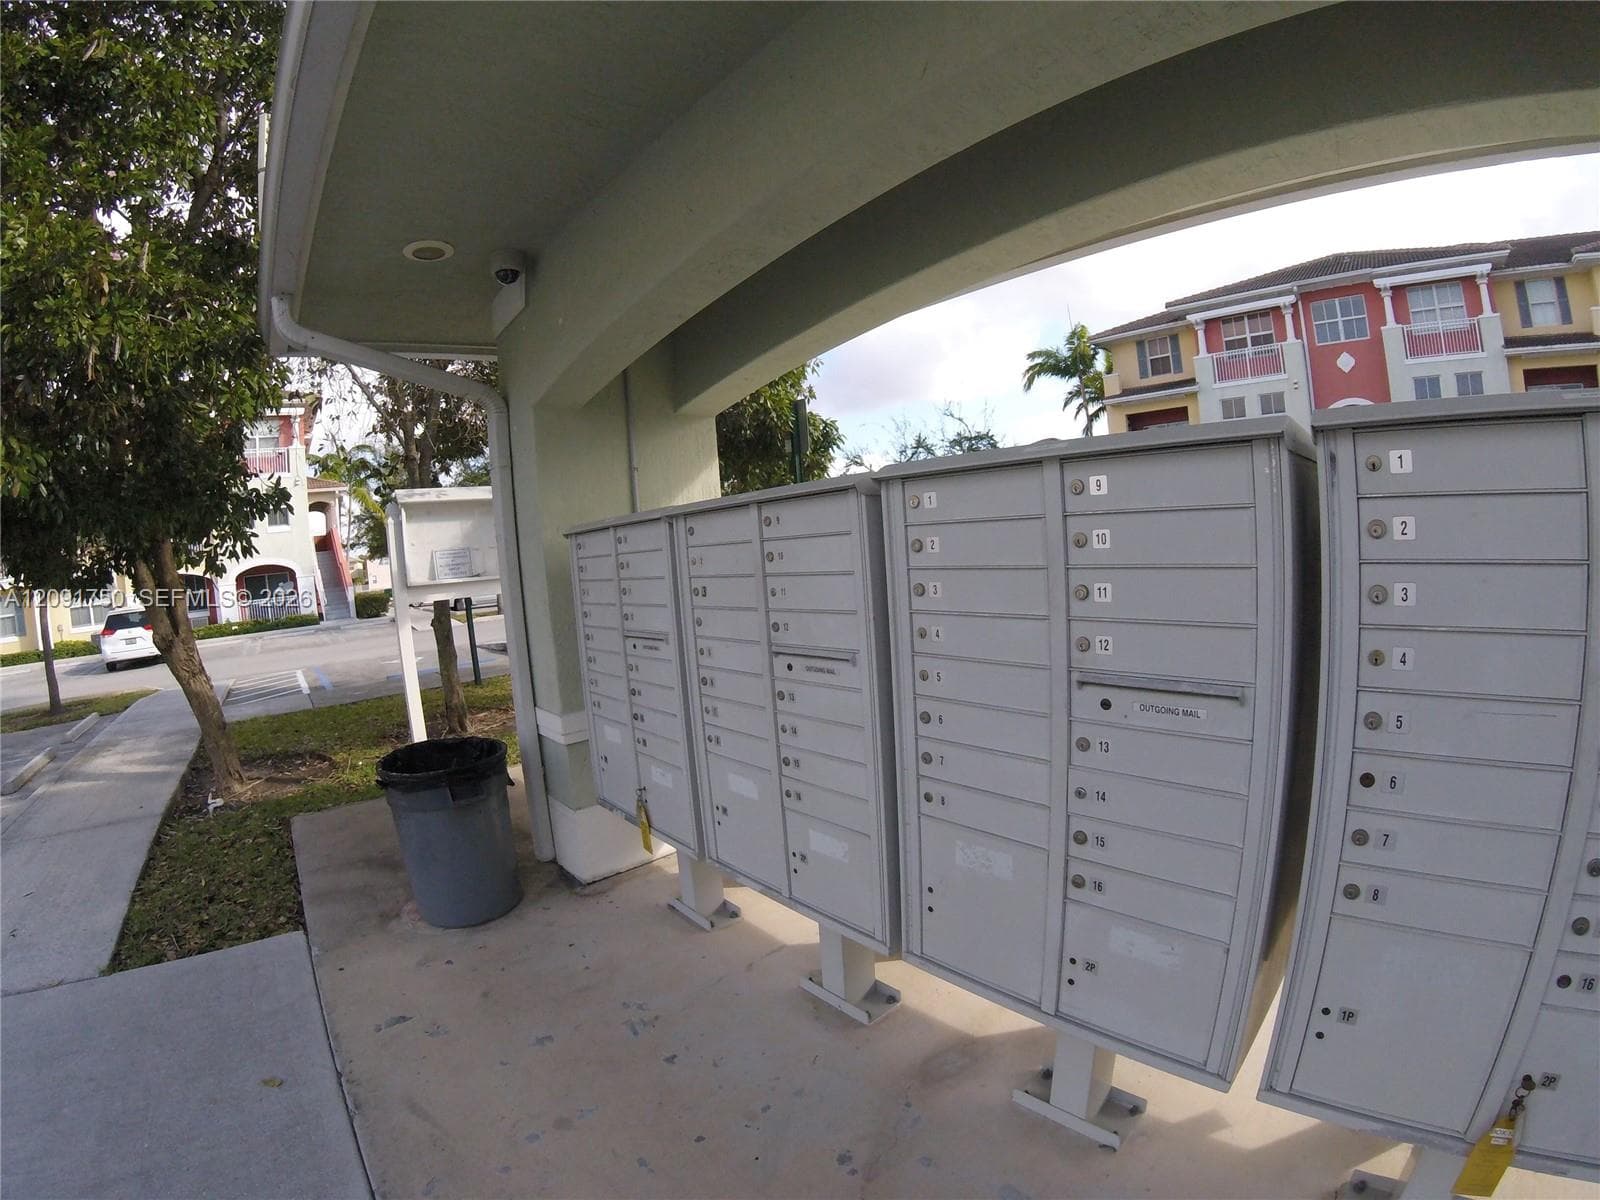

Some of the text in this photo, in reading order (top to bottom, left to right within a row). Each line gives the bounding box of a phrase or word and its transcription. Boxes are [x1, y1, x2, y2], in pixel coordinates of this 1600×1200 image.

[1096, 533, 1107, 545] 10
[1096, 587, 1108, 599] 11
[1098, 639, 1110, 651] 12
[1140, 704, 1201, 718] OUTGOING MAIL
[1098, 741, 1110, 753] 13
[1096, 791, 1106, 802] 14
[1095, 836, 1105, 848] 15
[1093, 880, 1103, 892] 16
[1085, 962, 1096, 972] 2P
[1582, 978, 1594, 990] 16
[1341, 1010, 1354, 1022] 1P
[1541, 1075, 1556, 1086] 2P
